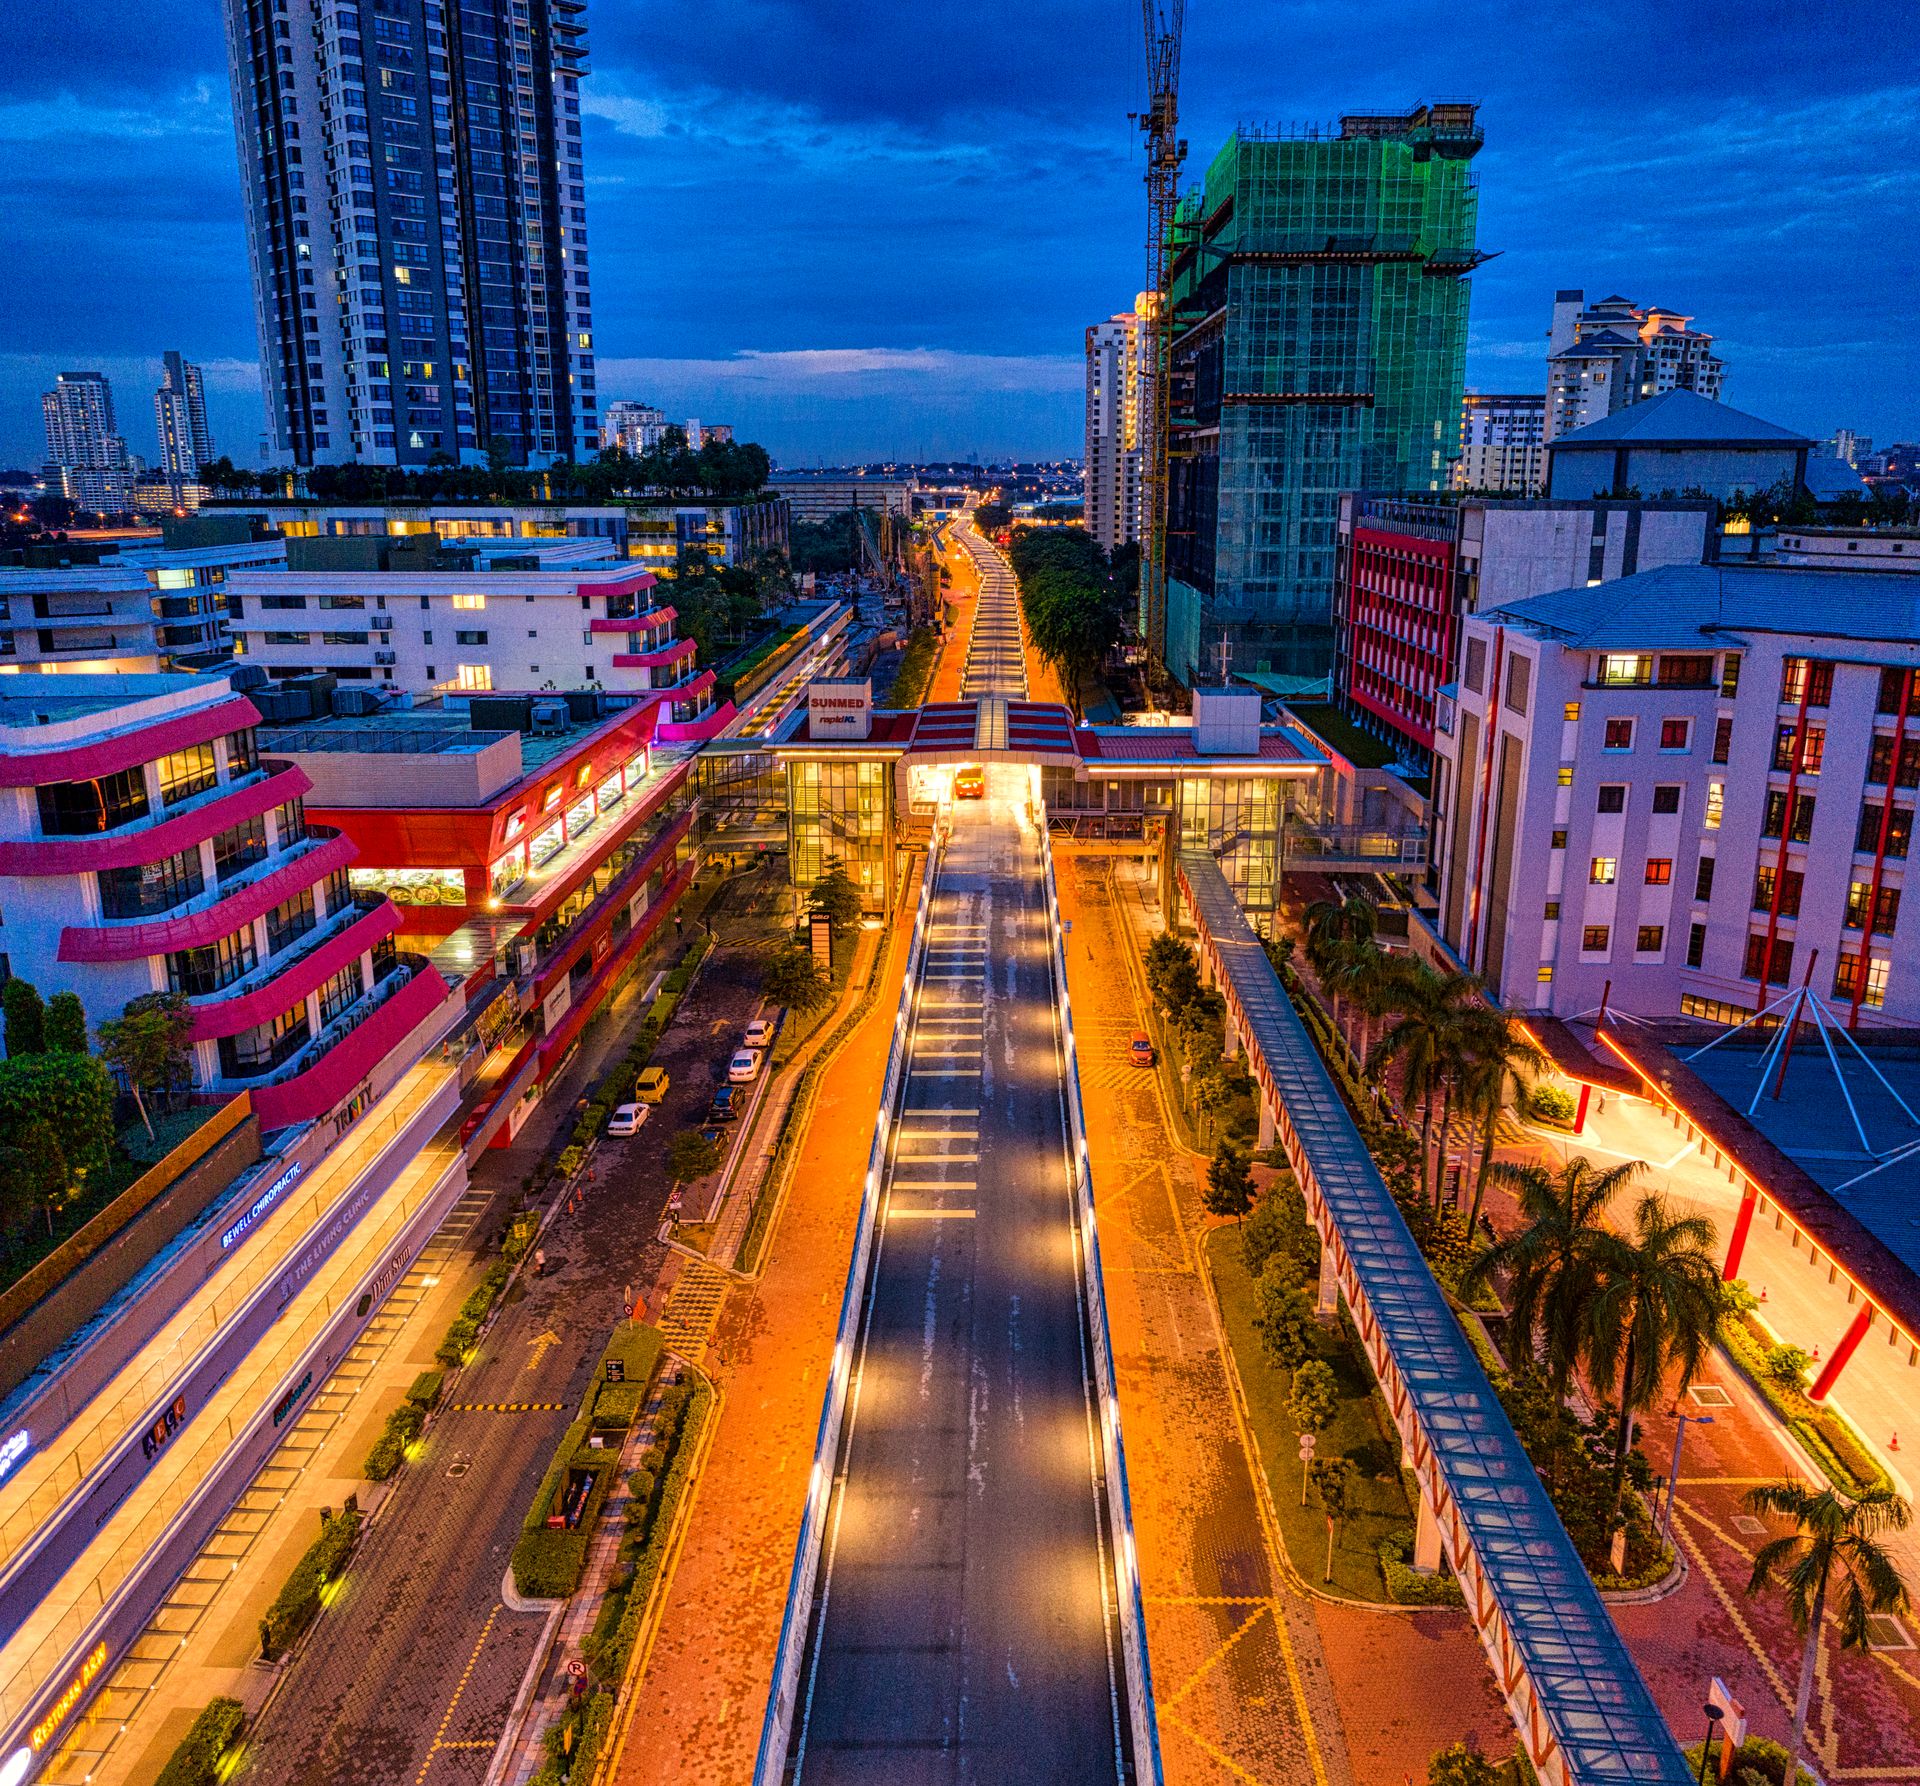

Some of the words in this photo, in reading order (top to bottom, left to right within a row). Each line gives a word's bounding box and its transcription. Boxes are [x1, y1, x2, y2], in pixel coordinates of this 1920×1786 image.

[811, 698, 865, 709] SUNMED
[222, 1213, 252, 1249] BEWELL
[252, 1161, 301, 1218] CHIROPRACTIC
[294, 1255, 313, 1280] THE
[343, 1189, 370, 1224] CLINIC
[371, 1270, 392, 1303] Dim
[391, 1245, 411, 1275] Sum
